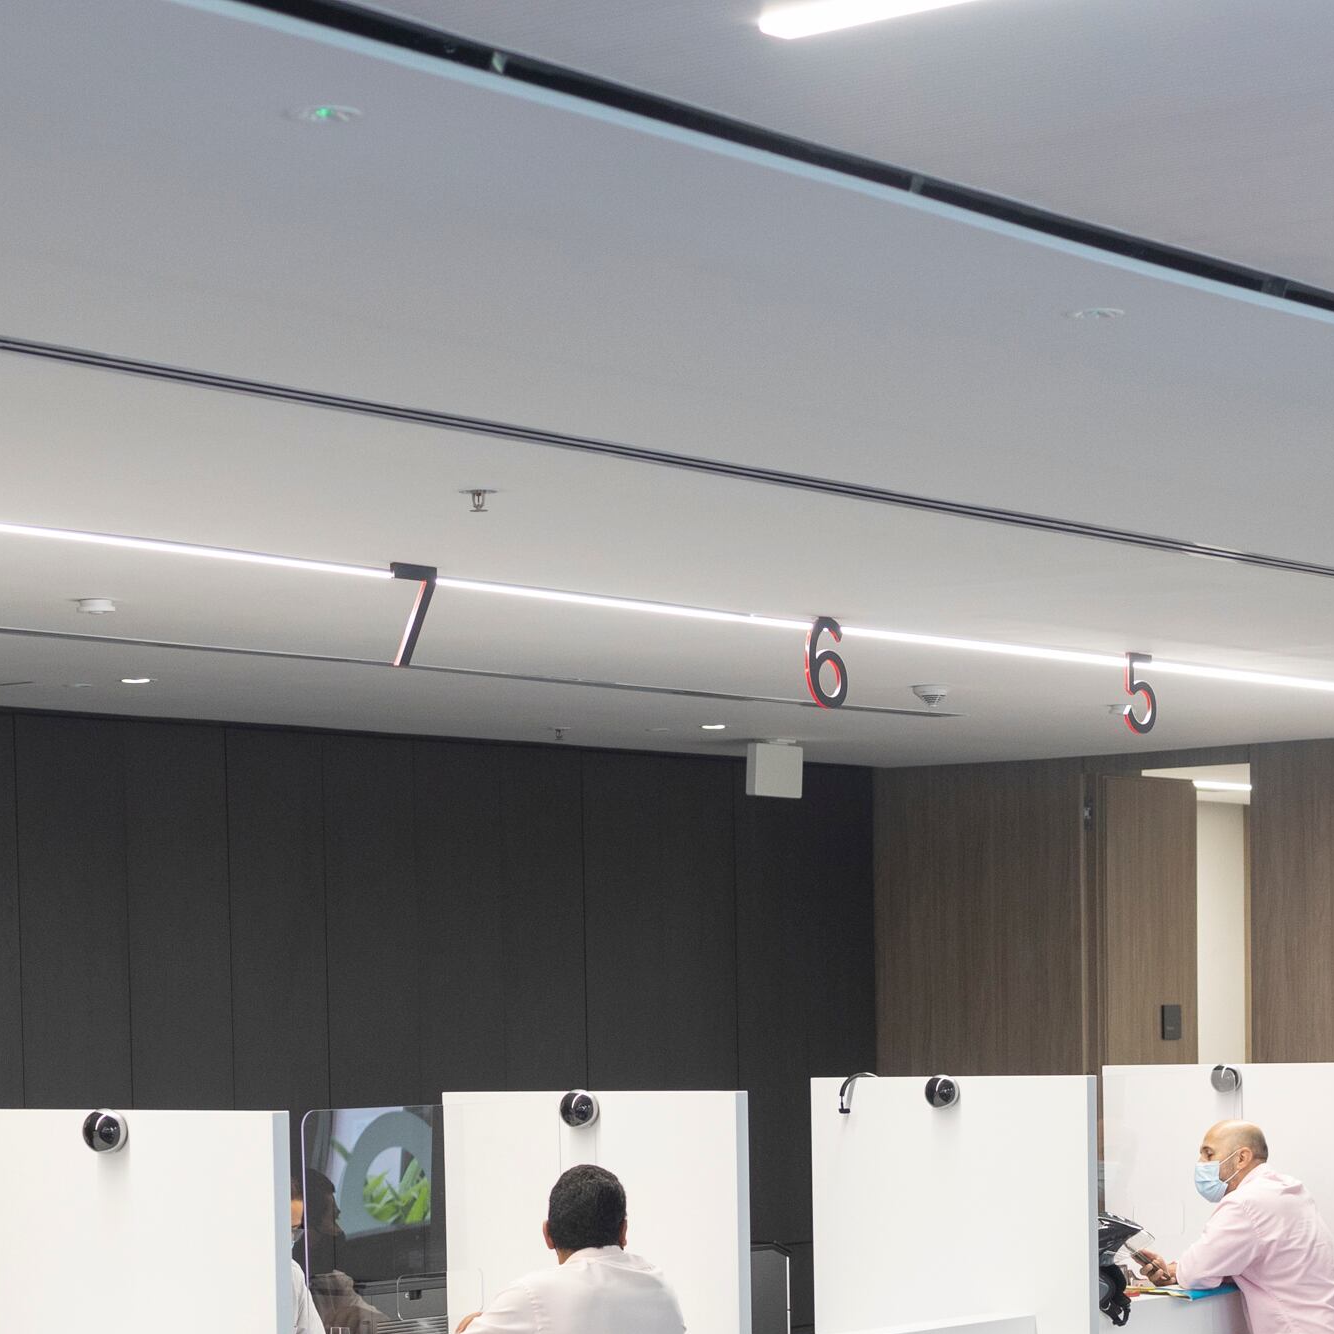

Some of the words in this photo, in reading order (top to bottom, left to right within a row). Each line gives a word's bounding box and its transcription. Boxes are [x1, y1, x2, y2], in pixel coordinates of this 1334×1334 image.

[390, 561, 437, 668] 7
[805, 616, 848, 710] 6
[1123, 652, 1157, 734] 5
